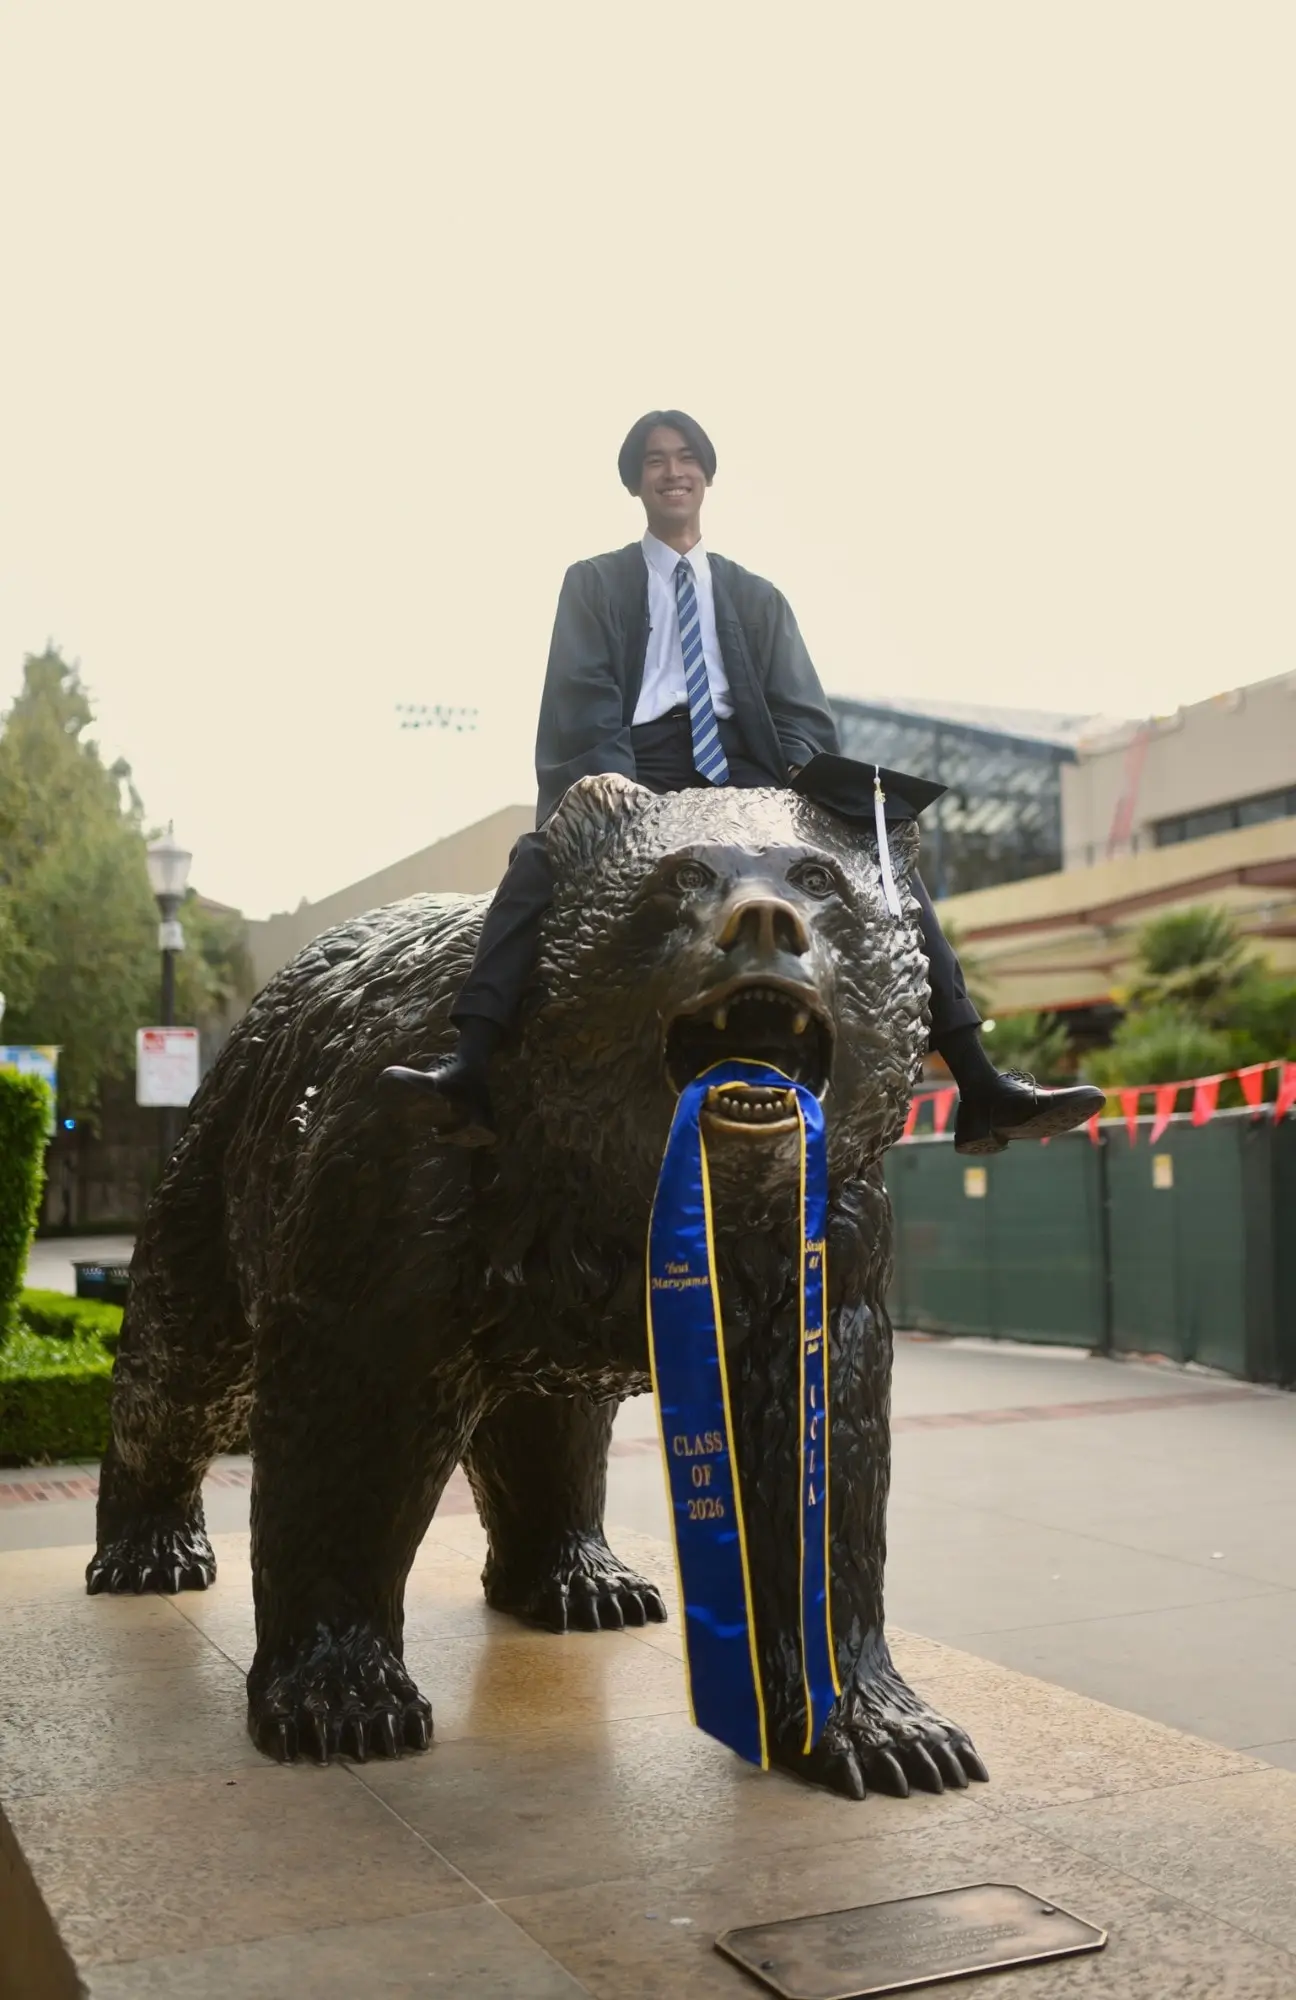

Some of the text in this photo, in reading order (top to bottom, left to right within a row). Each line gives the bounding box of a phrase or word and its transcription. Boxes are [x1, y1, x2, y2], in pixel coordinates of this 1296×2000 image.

[653, 1276, 708, 1291] Maruyama
[673, 1430, 723, 1456] CLASS
[692, 1464, 712, 1488] OF
[688, 1497, 725, 1520] 2026
